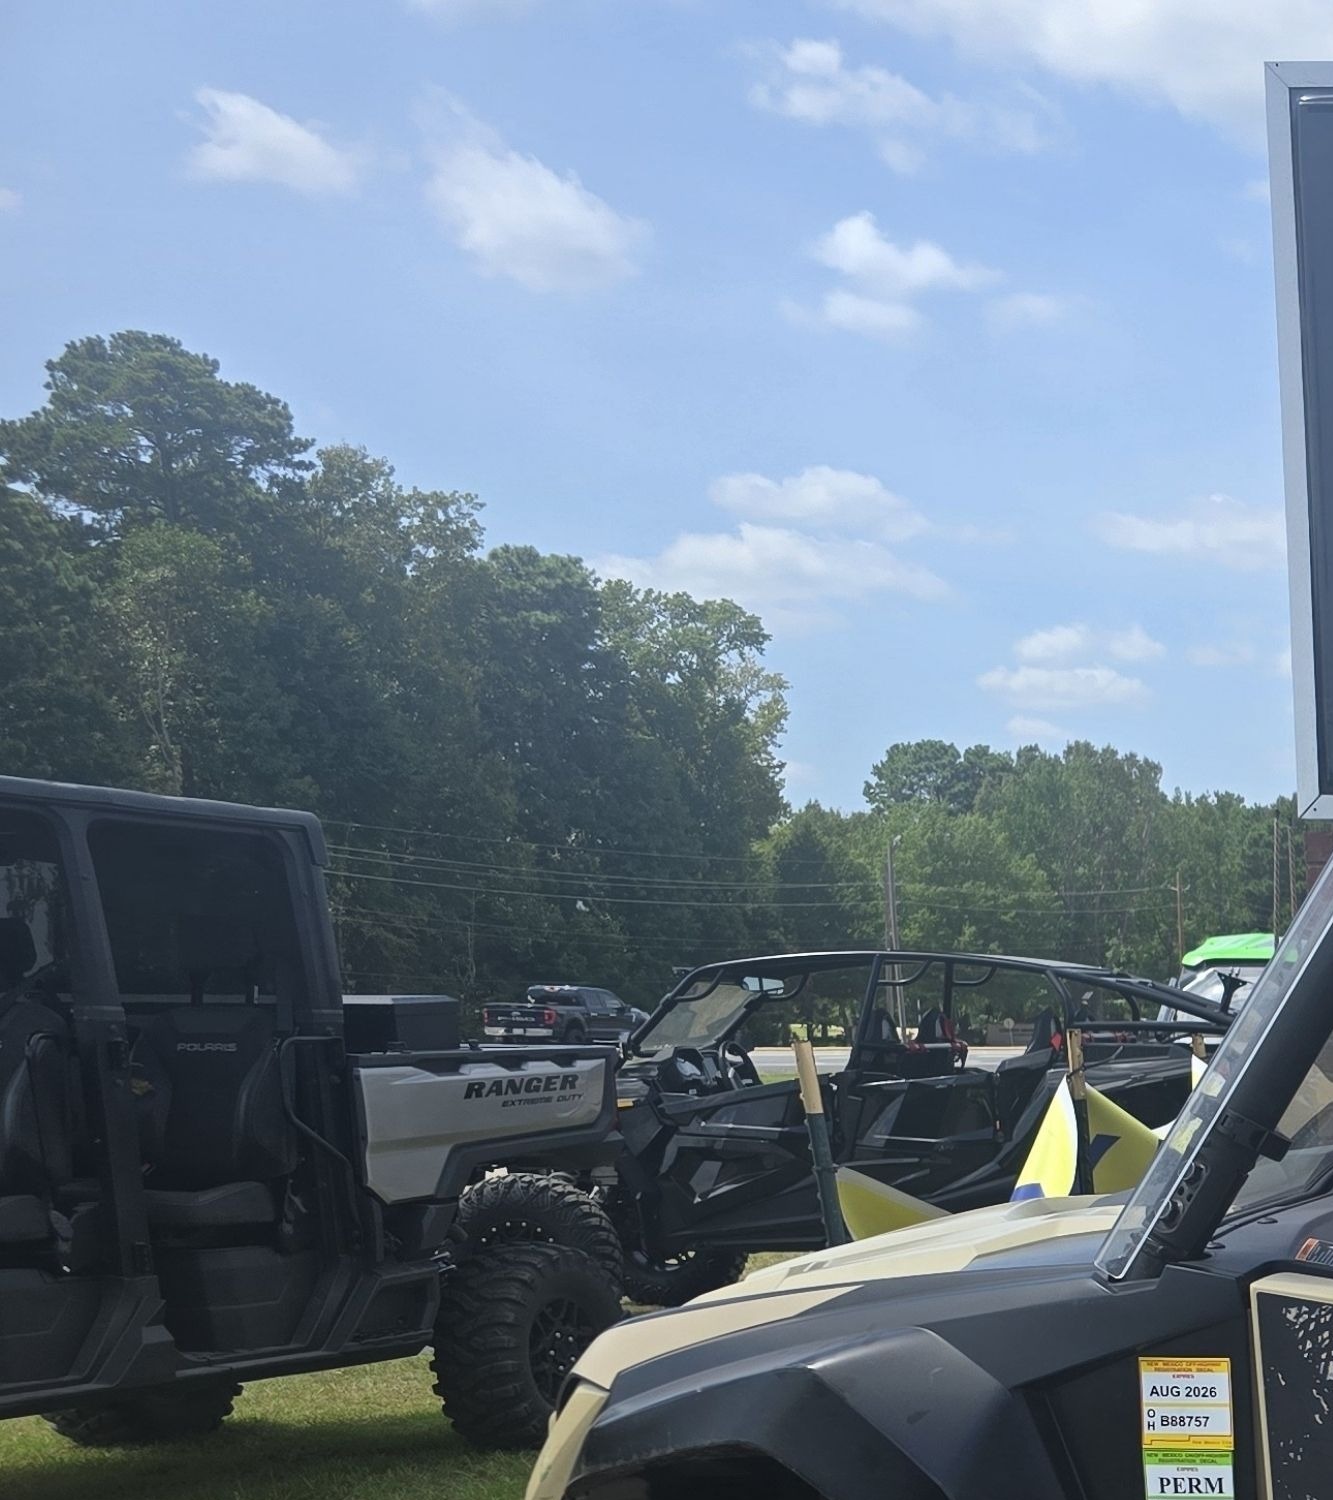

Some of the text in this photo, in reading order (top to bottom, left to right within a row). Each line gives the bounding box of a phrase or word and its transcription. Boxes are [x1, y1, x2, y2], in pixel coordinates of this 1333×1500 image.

[177, 1042, 237, 1052] POLARIS
[463, 1074, 580, 1100] RANGER
[502, 1093, 585, 1107] EXTREME DUTY
[1149, 1385, 1217, 1398] AUG 2026
[1160, 1415, 1210, 1427] B88757
[1158, 1476, 1225, 1494] PERM
